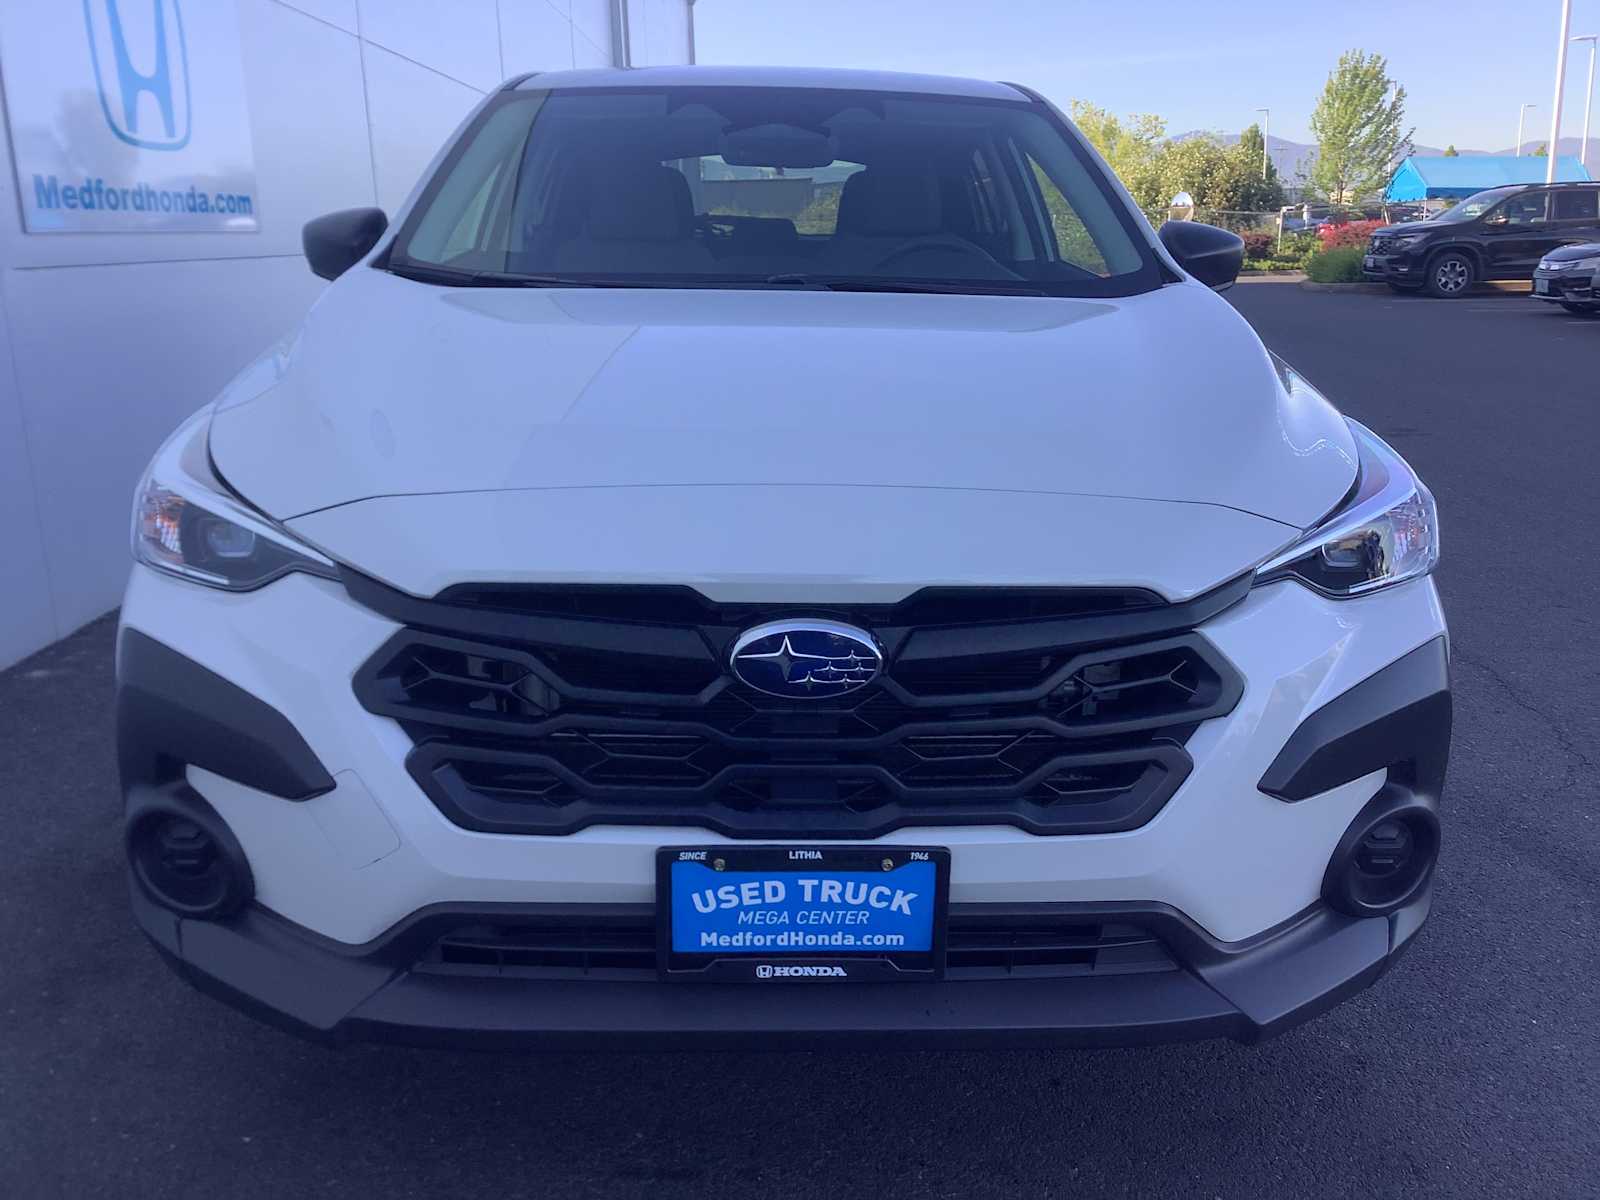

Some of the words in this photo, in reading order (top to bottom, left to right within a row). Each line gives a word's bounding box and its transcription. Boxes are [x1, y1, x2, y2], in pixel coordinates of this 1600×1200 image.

[32, 174, 253, 214] Medfordhonda.com
[679, 851, 706, 861] SINCE
[788, 850, 822, 860] LITHIA
[691, 879, 786, 914] USED
[797, 879, 919, 916] TRUCK
[737, 911, 790, 925] MEGA
[796, 911, 870, 925] CENTER
[700, 931, 904, 947] MedfordHonda.com
[774, 966, 847, 977] HONDA
